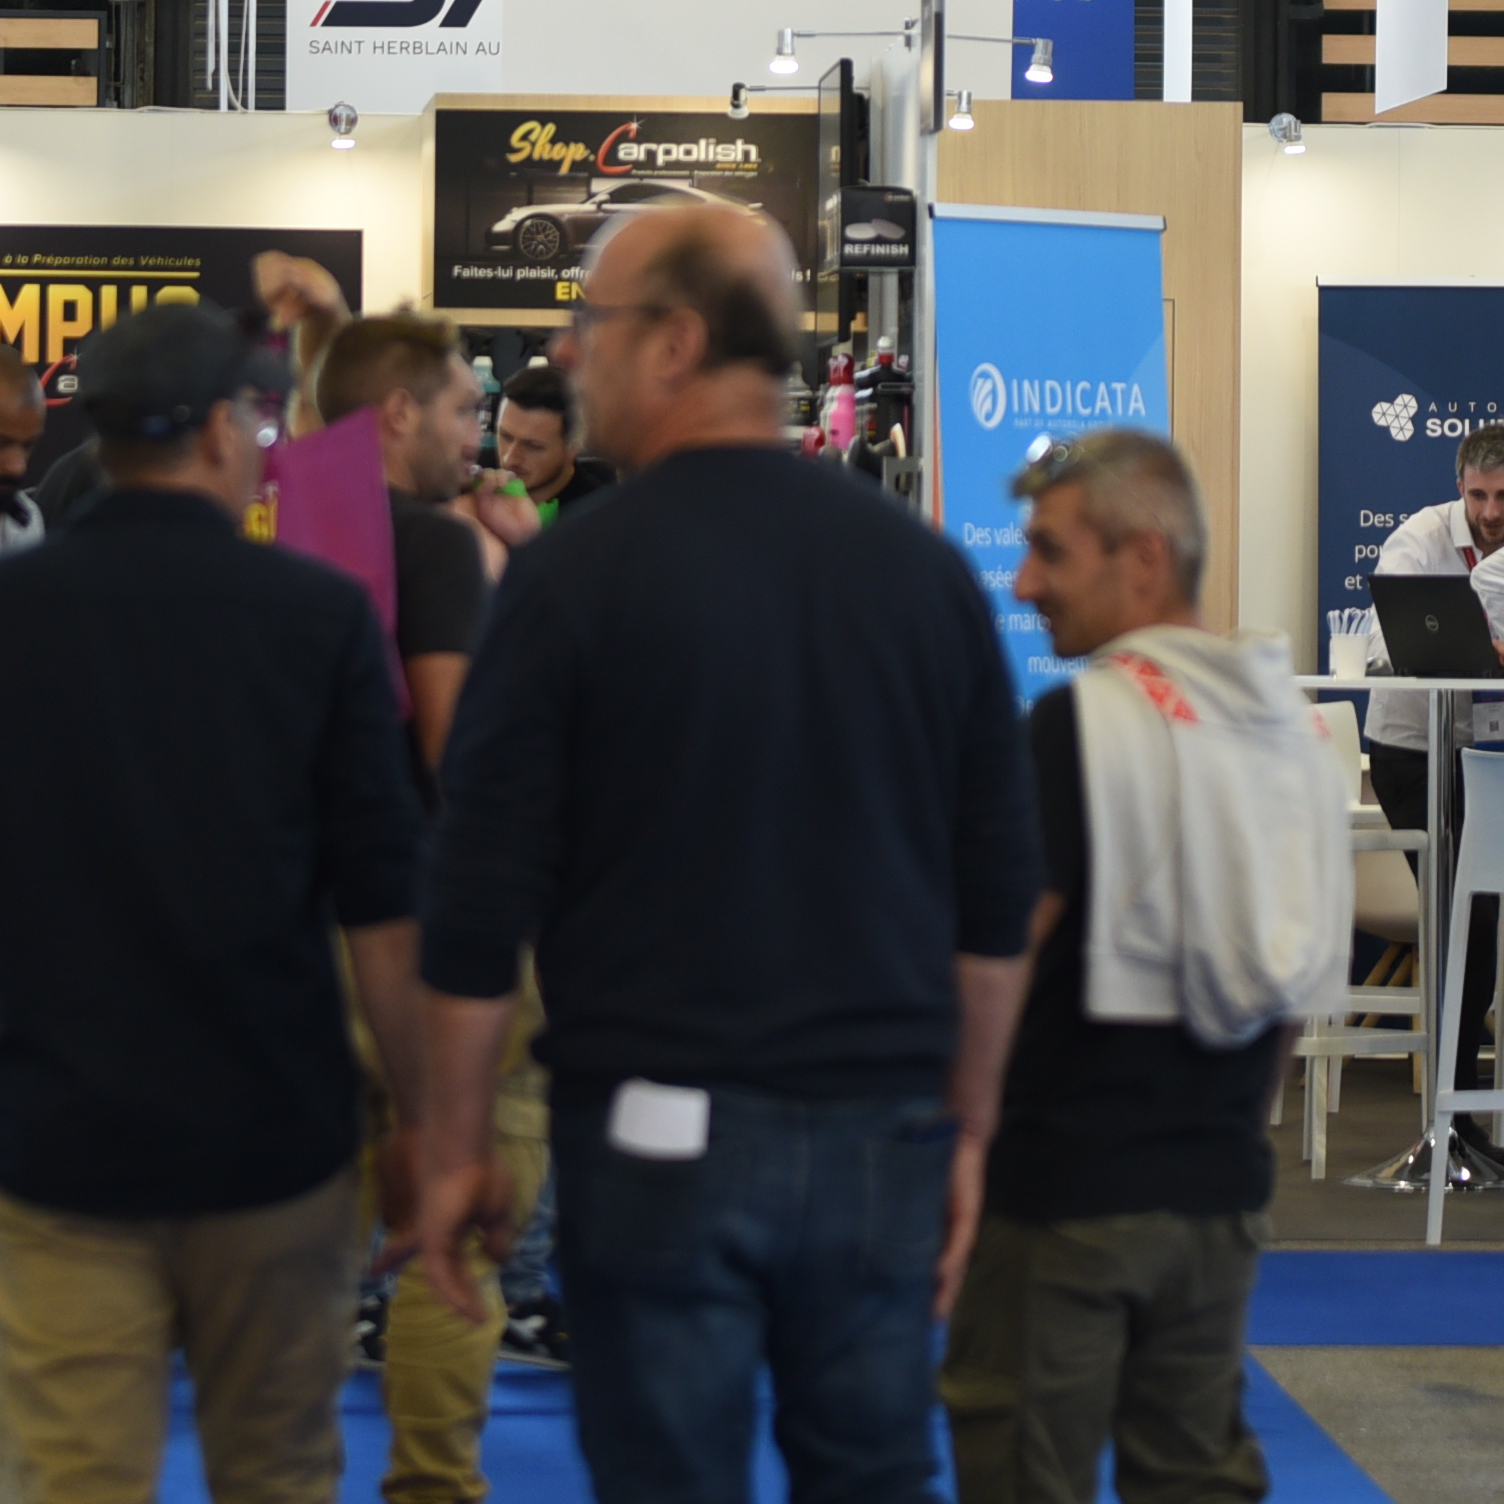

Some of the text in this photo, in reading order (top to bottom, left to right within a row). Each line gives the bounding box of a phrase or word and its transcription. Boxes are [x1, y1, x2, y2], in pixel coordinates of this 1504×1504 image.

[308, 40, 365, 55] SAINT
[372, 40, 468, 56] HERBLAIN
[597, 122, 759, 174] Carpolish
[844, 244, 909, 255] REFINISH
[16, 253, 29, 265] la
[32, 253, 109, 269] Préparation
[112, 255, 135, 267] des
[139, 254, 202, 268] Véhicules
[452, 264, 513, 280] Faites-lui
[516, 265, 559, 283] plaisir,
[1012, 378, 1146, 417] INDICATA
[1360, 510, 1395, 527] Des
[964, 522, 1030, 546] Des vale
[978, 565, 1020, 589] asées
[1344, 575, 1363, 590] et
[1008, 610, 1051, 632] marc
